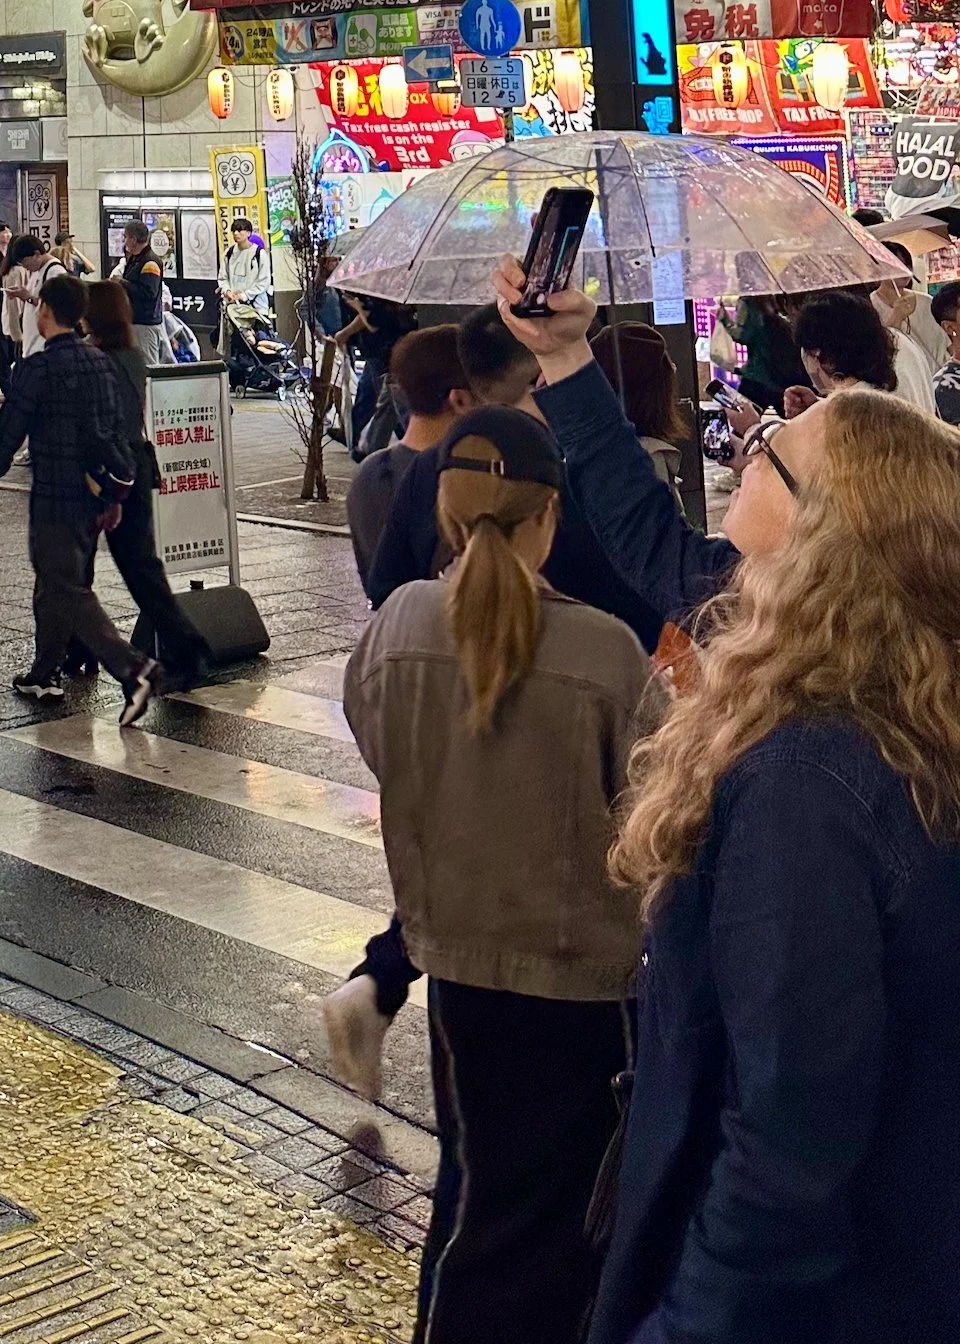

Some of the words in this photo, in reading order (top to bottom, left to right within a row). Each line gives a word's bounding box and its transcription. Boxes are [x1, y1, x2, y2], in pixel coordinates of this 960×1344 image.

[684, 3, 759, 41] 免税
[410, 93, 428, 104] ax
[782, 108, 809, 122] TAX
[390, 121, 418, 133] cash
[787, 144, 838, 152] KABUKICHO
[896, 131, 956, 157] HALAL
[393, 146, 431, 163] 3rd
[897, 156, 951, 181] OOD
[155, 425, 215, 446] 車両進入禁止
[162, 457, 211, 473] (新宿区内全域)
[159, 471, 220, 496] 路上喫煙禁止
